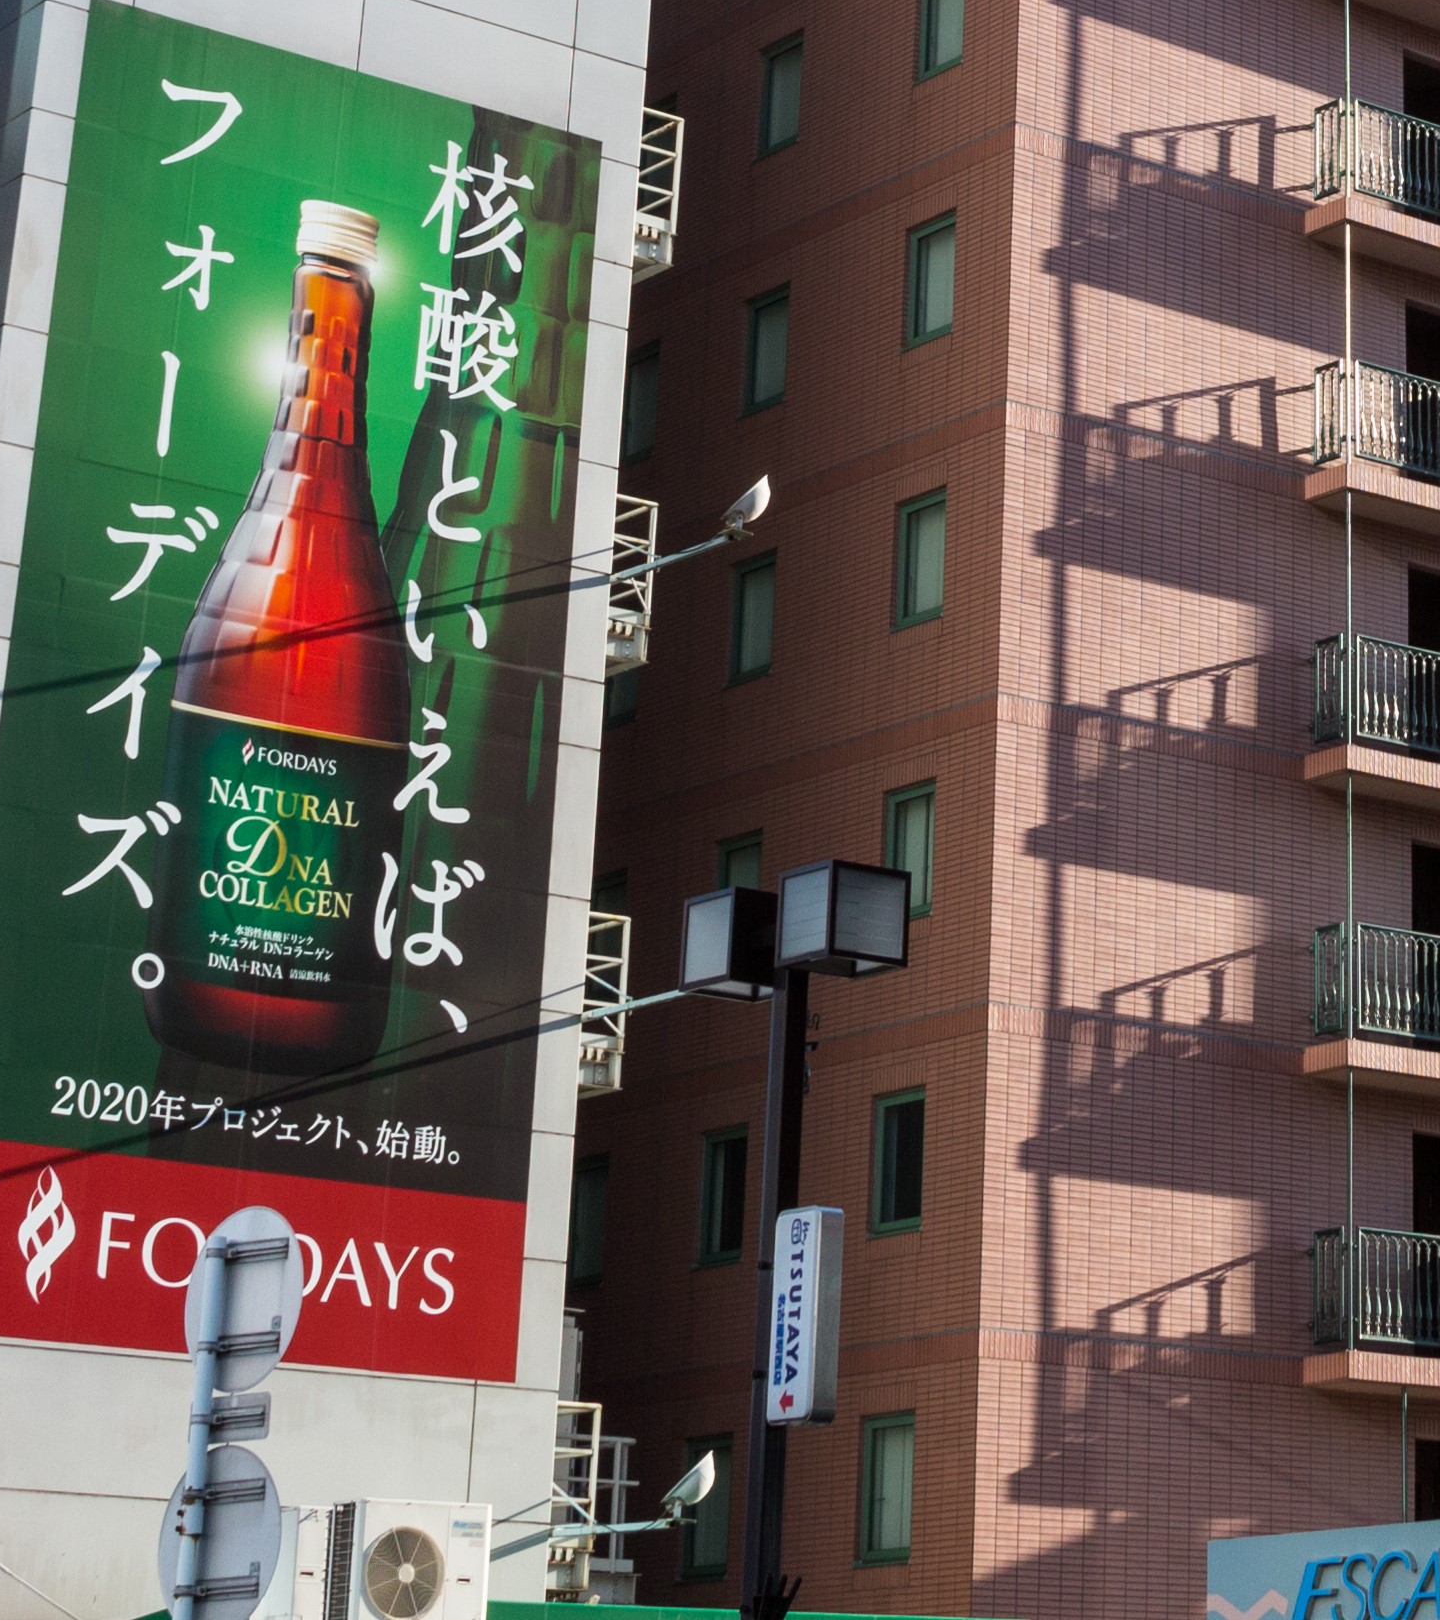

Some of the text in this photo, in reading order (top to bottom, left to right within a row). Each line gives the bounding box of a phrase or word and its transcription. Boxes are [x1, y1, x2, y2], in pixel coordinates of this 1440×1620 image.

[374, 140, 535, 1034] 核酸といえば、
[257, 746, 337, 776] FORDAYS
[208, 776, 360, 828] NATURAL
[198, 870, 353, 919] COLLAGEN
[208, 952, 283, 980] DNA+RNA
[51, 1075, 460, 1166] 2020年プロジェクト、始動。
[97, 1209, 456, 1316] FODAYS
[784, 1249, 804, 1385] TSUTAYA
